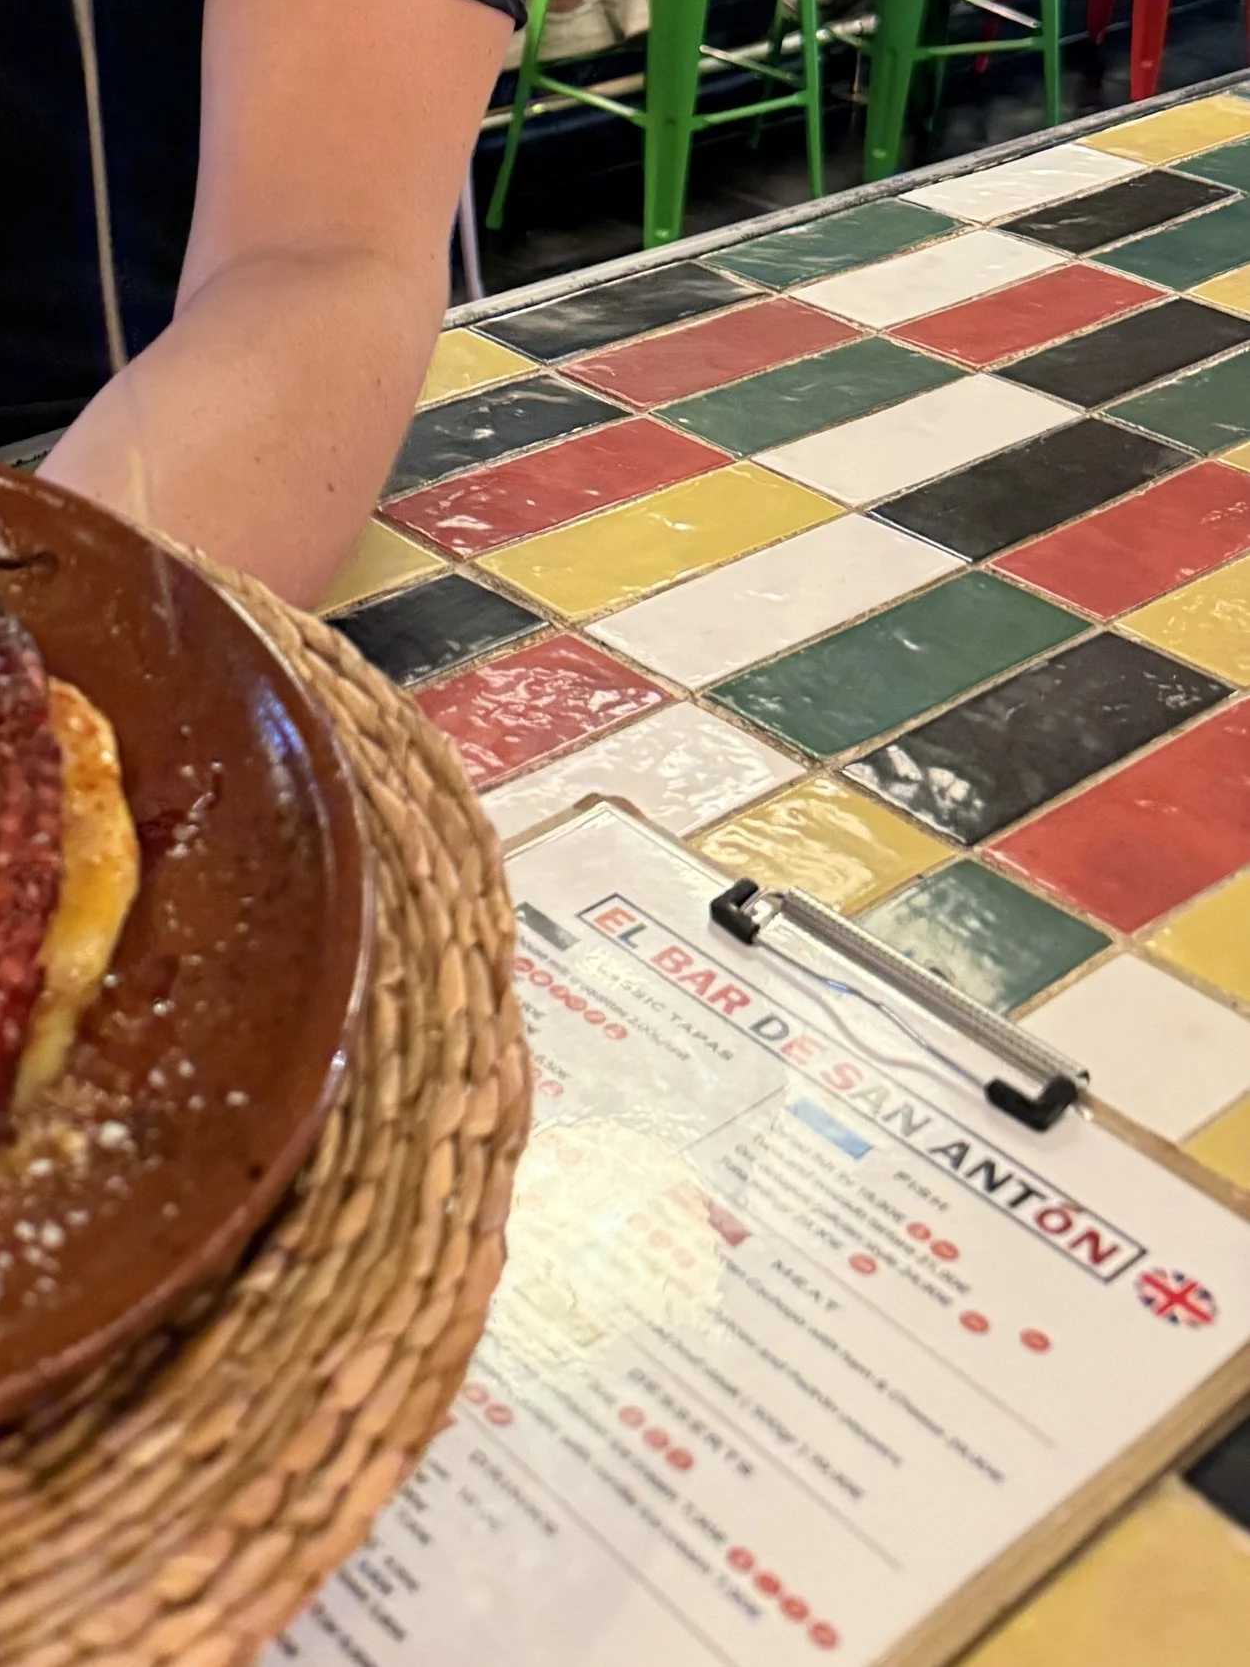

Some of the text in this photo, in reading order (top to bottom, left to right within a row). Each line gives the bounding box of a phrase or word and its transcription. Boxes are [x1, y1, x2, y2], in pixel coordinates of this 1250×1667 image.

[669, 1011, 734, 1062] TAPAS
[593, 906, 647, 949] EL
[650, 945, 751, 1016] BAR
[749, 1013, 829, 1066] DE
[819, 1061, 932, 1138] SAN
[928, 1139, 1121, 1266] ANTÓN
[770, 1259, 841, 1312] MEAT
[627, 1367, 754, 1477] DESSERTS
